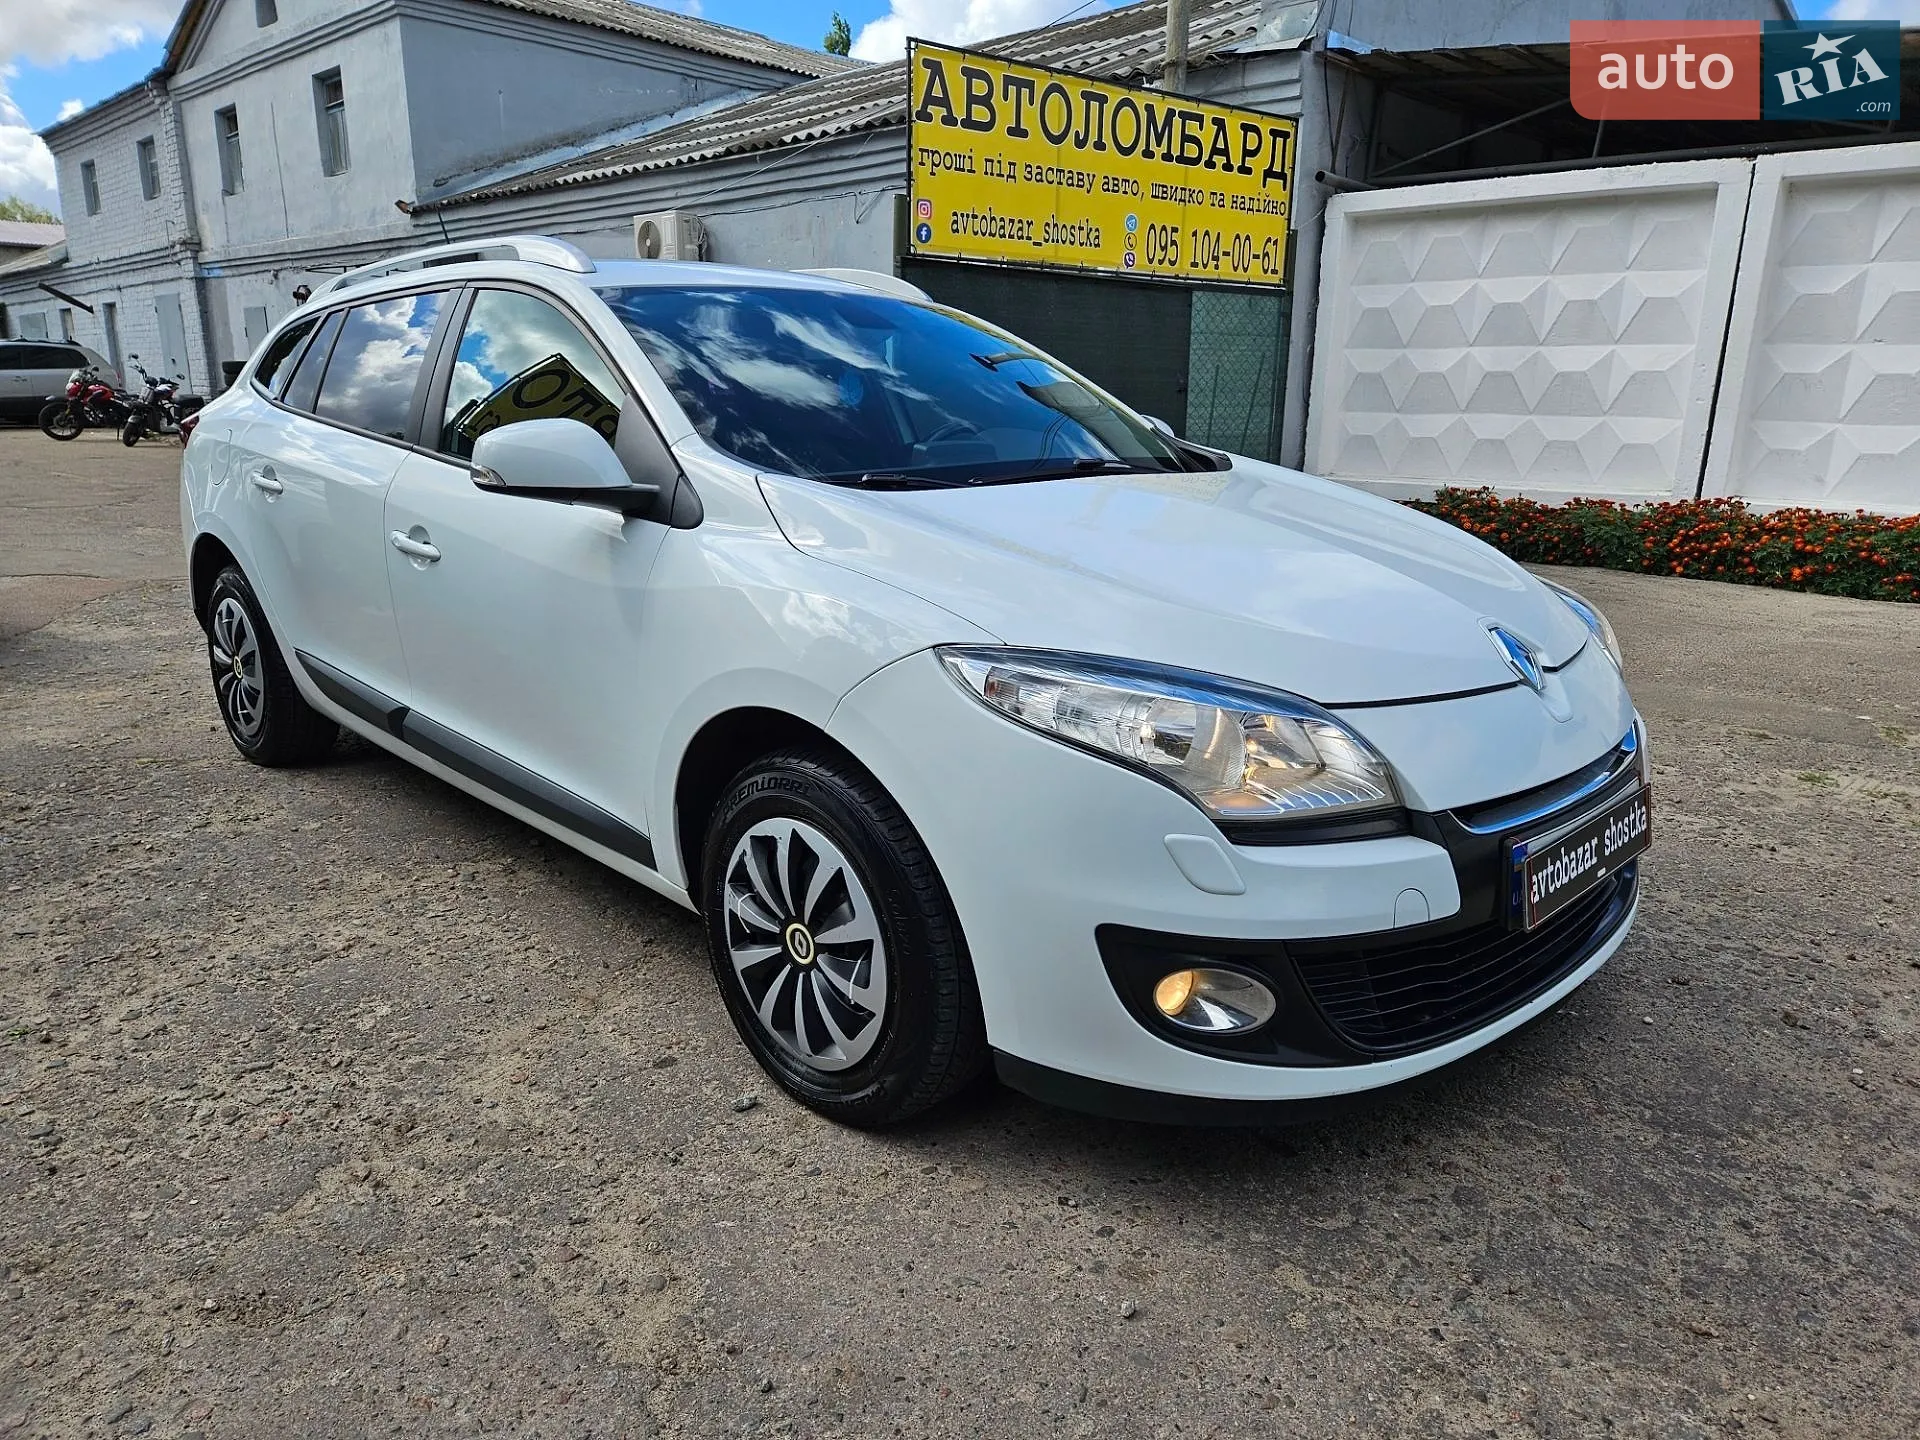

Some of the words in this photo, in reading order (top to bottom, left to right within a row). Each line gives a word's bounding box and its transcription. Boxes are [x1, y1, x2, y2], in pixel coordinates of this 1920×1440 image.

[915, 57, 1291, 192] АВТОЛОМБАРД
[918, 147, 976, 176] гроші
[983, 153, 1017, 183] під
[1023, 161, 1096, 194] заставу
[1101, 174, 1145, 202] авто,
[1150, 182, 1204, 206] швидко
[1209, 191, 1226, 209] та
[1230, 192, 1287, 216] надійно
[950, 206, 1101, 249] avtobazar_shostka
[1146, 223, 1179, 266] 095
[1190, 228, 1279, 275] 104-00-61
[1531, 801, 1647, 903] avtobazar_shostka
